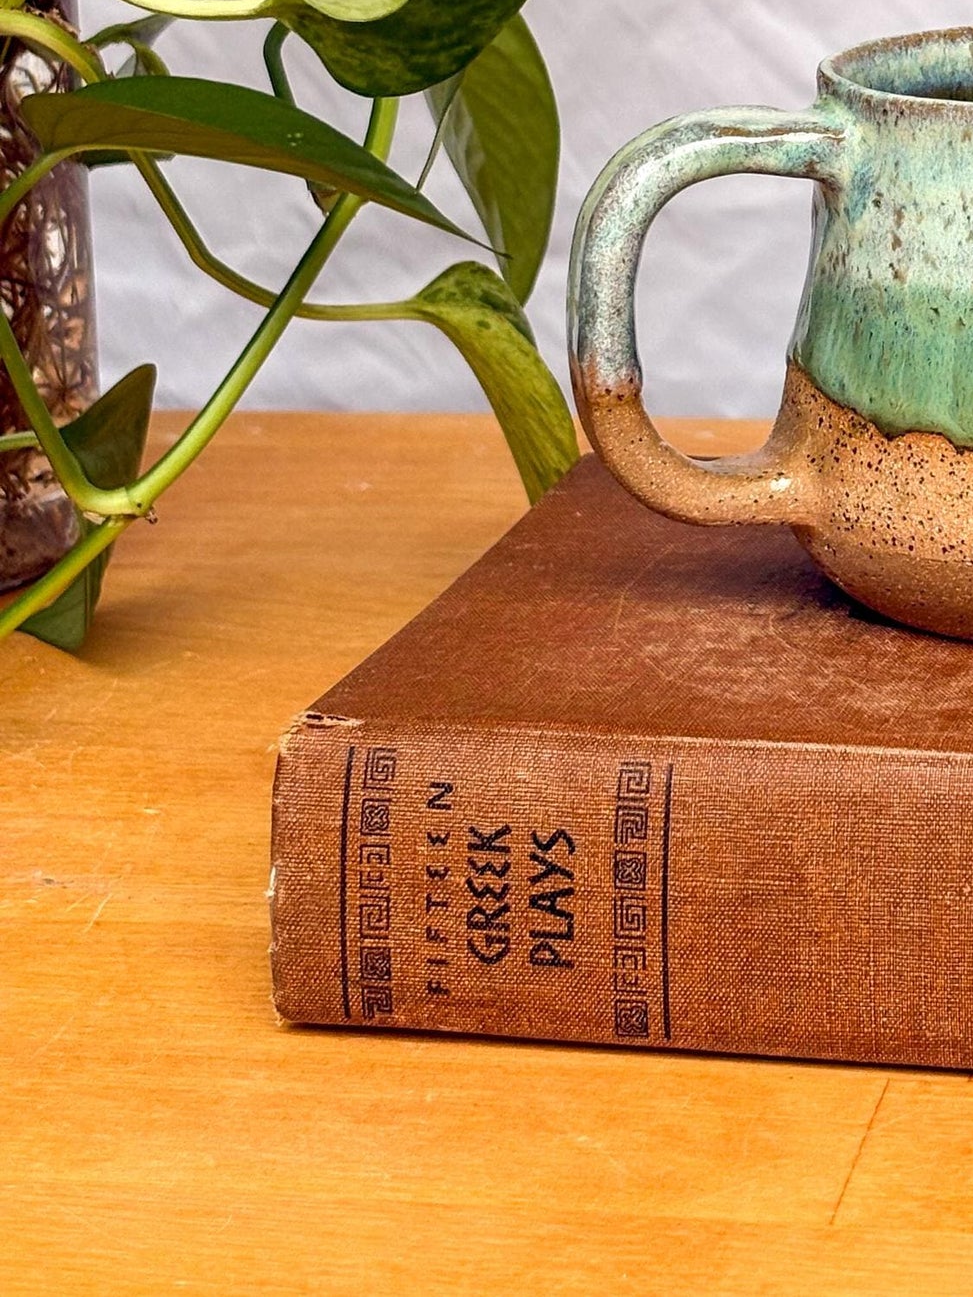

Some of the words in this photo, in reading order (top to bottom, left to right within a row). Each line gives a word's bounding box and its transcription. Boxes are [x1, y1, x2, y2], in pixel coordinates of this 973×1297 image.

[426, 782, 454, 996] FIFTEEN
[467, 824, 512, 965] GREEK
[530, 828, 575, 968] PLAYS
